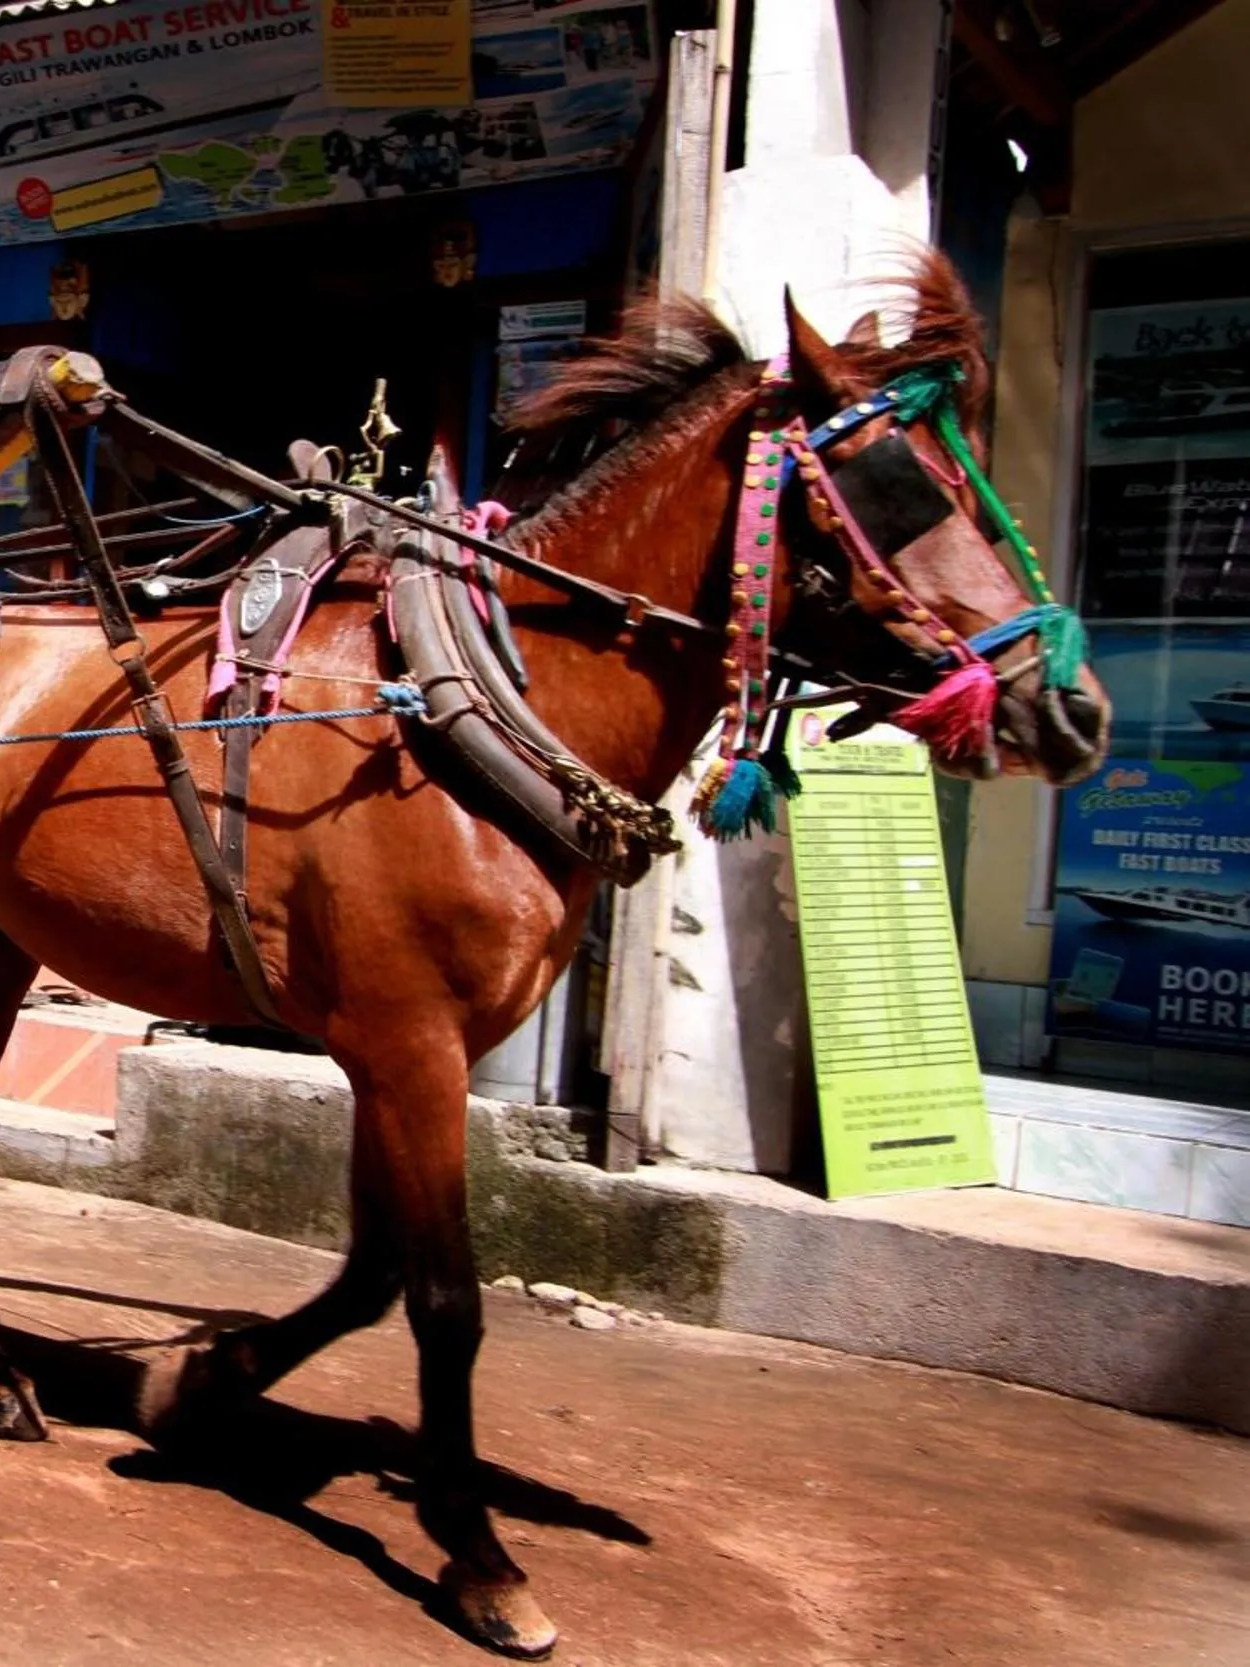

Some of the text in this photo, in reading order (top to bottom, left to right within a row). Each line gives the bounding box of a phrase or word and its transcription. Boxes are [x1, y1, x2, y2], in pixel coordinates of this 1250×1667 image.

[0, 68, 37, 87] GILI
[44, 40, 180, 78] TRAWANGAN
[187, 40, 203, 54] &
[210, 18, 313, 50] LOMBOK
[63, 16, 152, 54] BOAT
